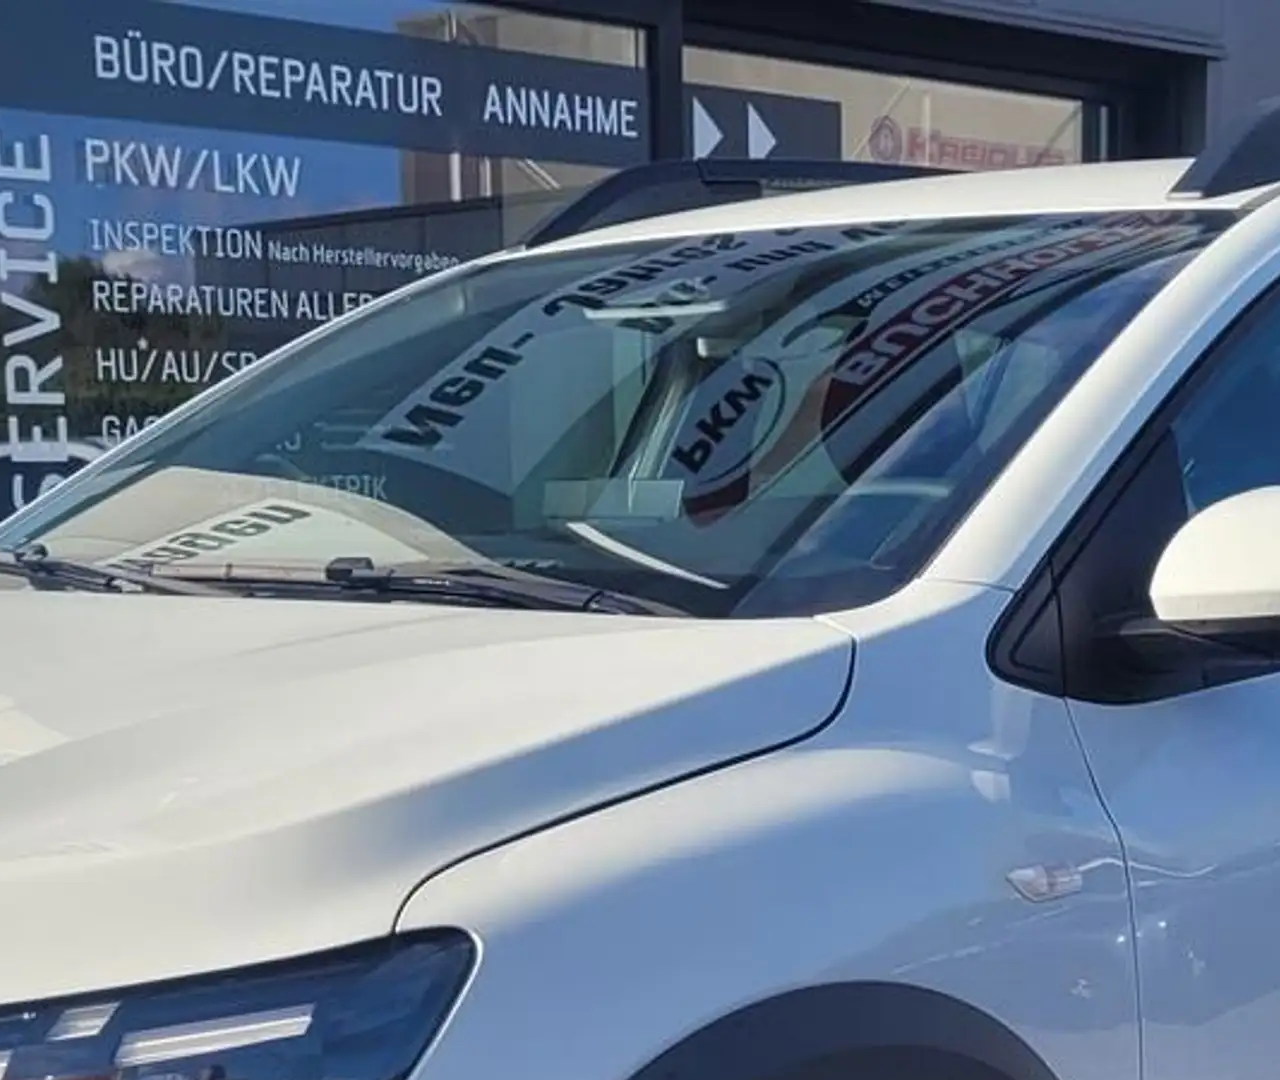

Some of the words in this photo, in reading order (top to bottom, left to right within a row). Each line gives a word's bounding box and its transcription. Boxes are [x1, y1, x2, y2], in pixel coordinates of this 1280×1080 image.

[94, 31, 442, 116] BÜRO/REPARATUR
[483, 84, 639, 138] ANNAHME
[84, 137, 301, 198] PKW/LKW
[90, 218, 262, 260] INSPEKTION
[268, 243, 311, 264] Nach
[92, 280, 288, 318] REPARATUREN
